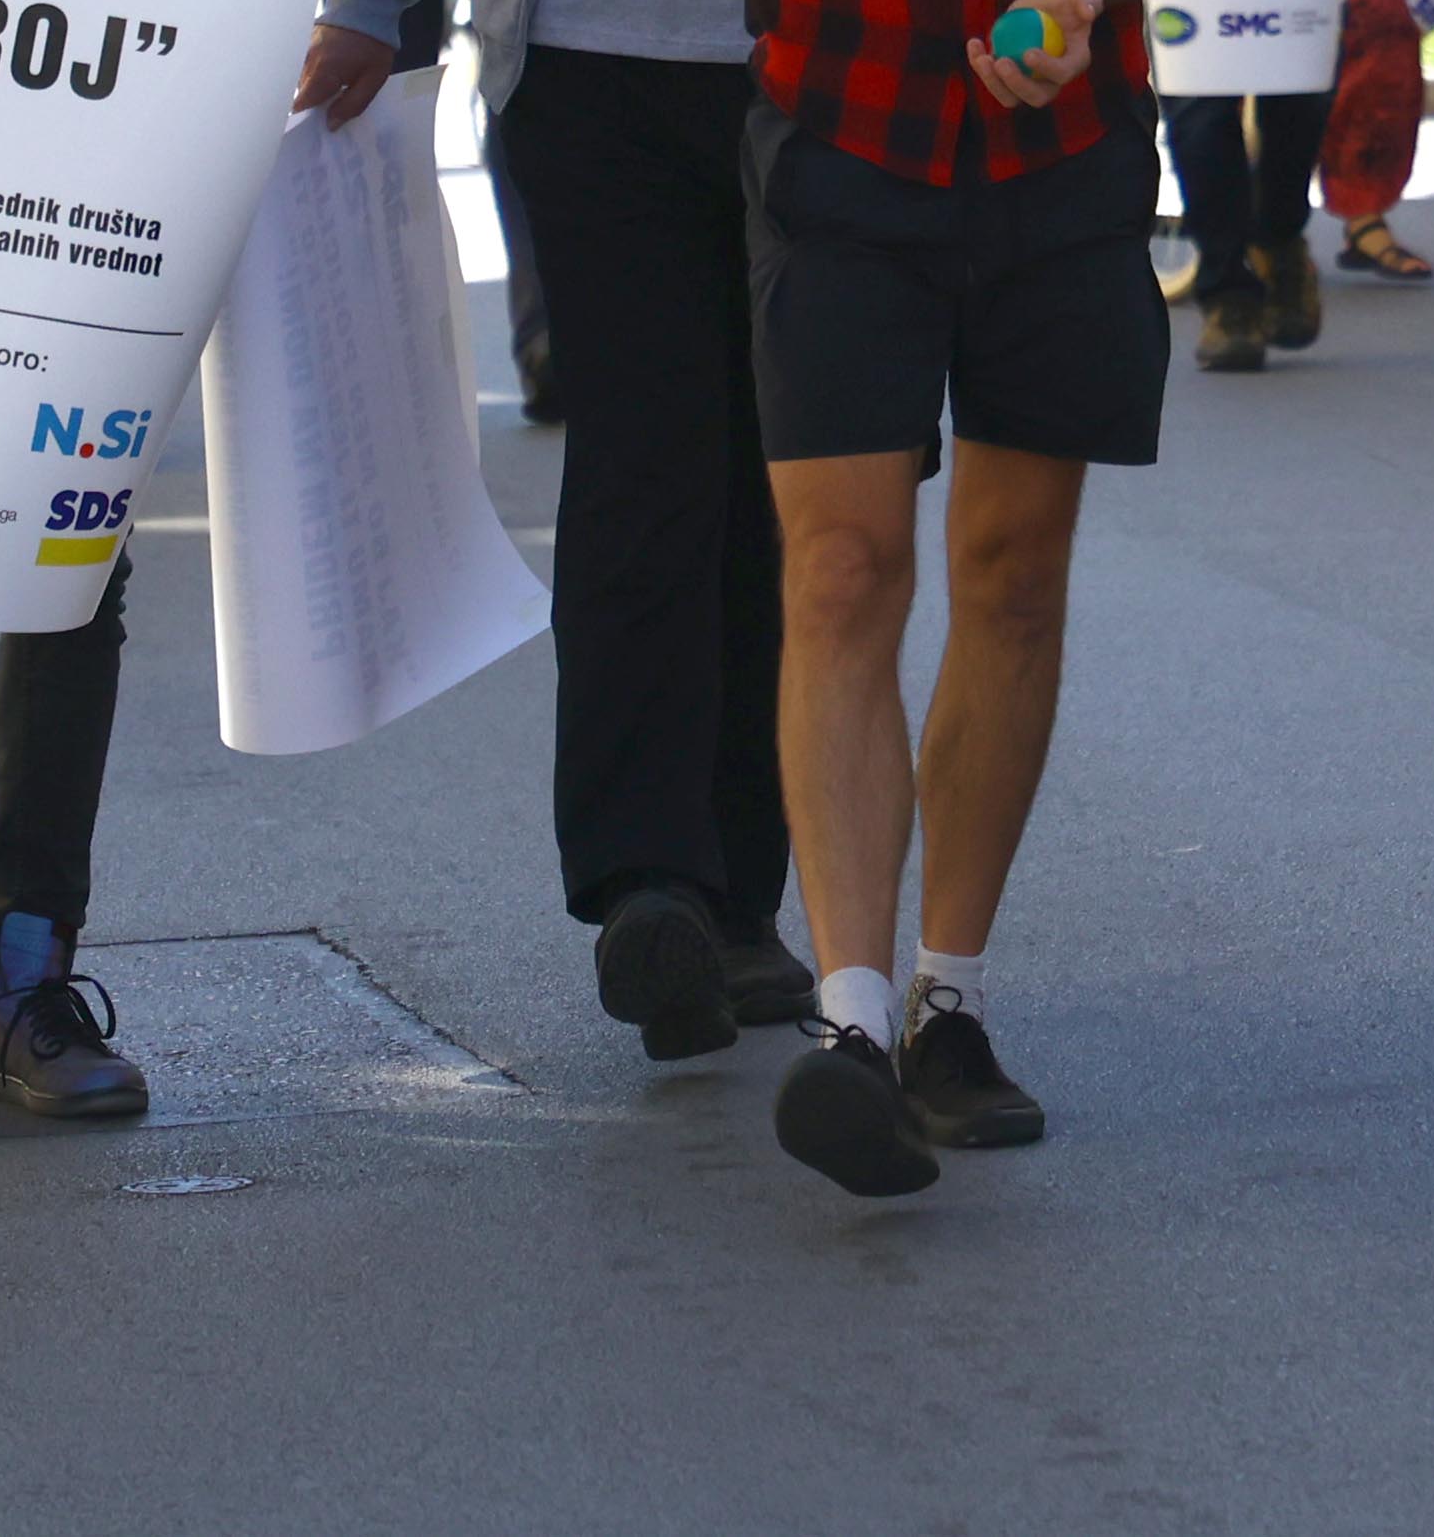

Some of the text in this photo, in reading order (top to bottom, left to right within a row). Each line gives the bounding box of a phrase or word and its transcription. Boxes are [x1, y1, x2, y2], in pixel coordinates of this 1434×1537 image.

[68, 203, 162, 241] društva
[69, 242, 163, 278] vrednot
[31, 402, 152, 461] N.Si
[45, 488, 133, 532] SDS
